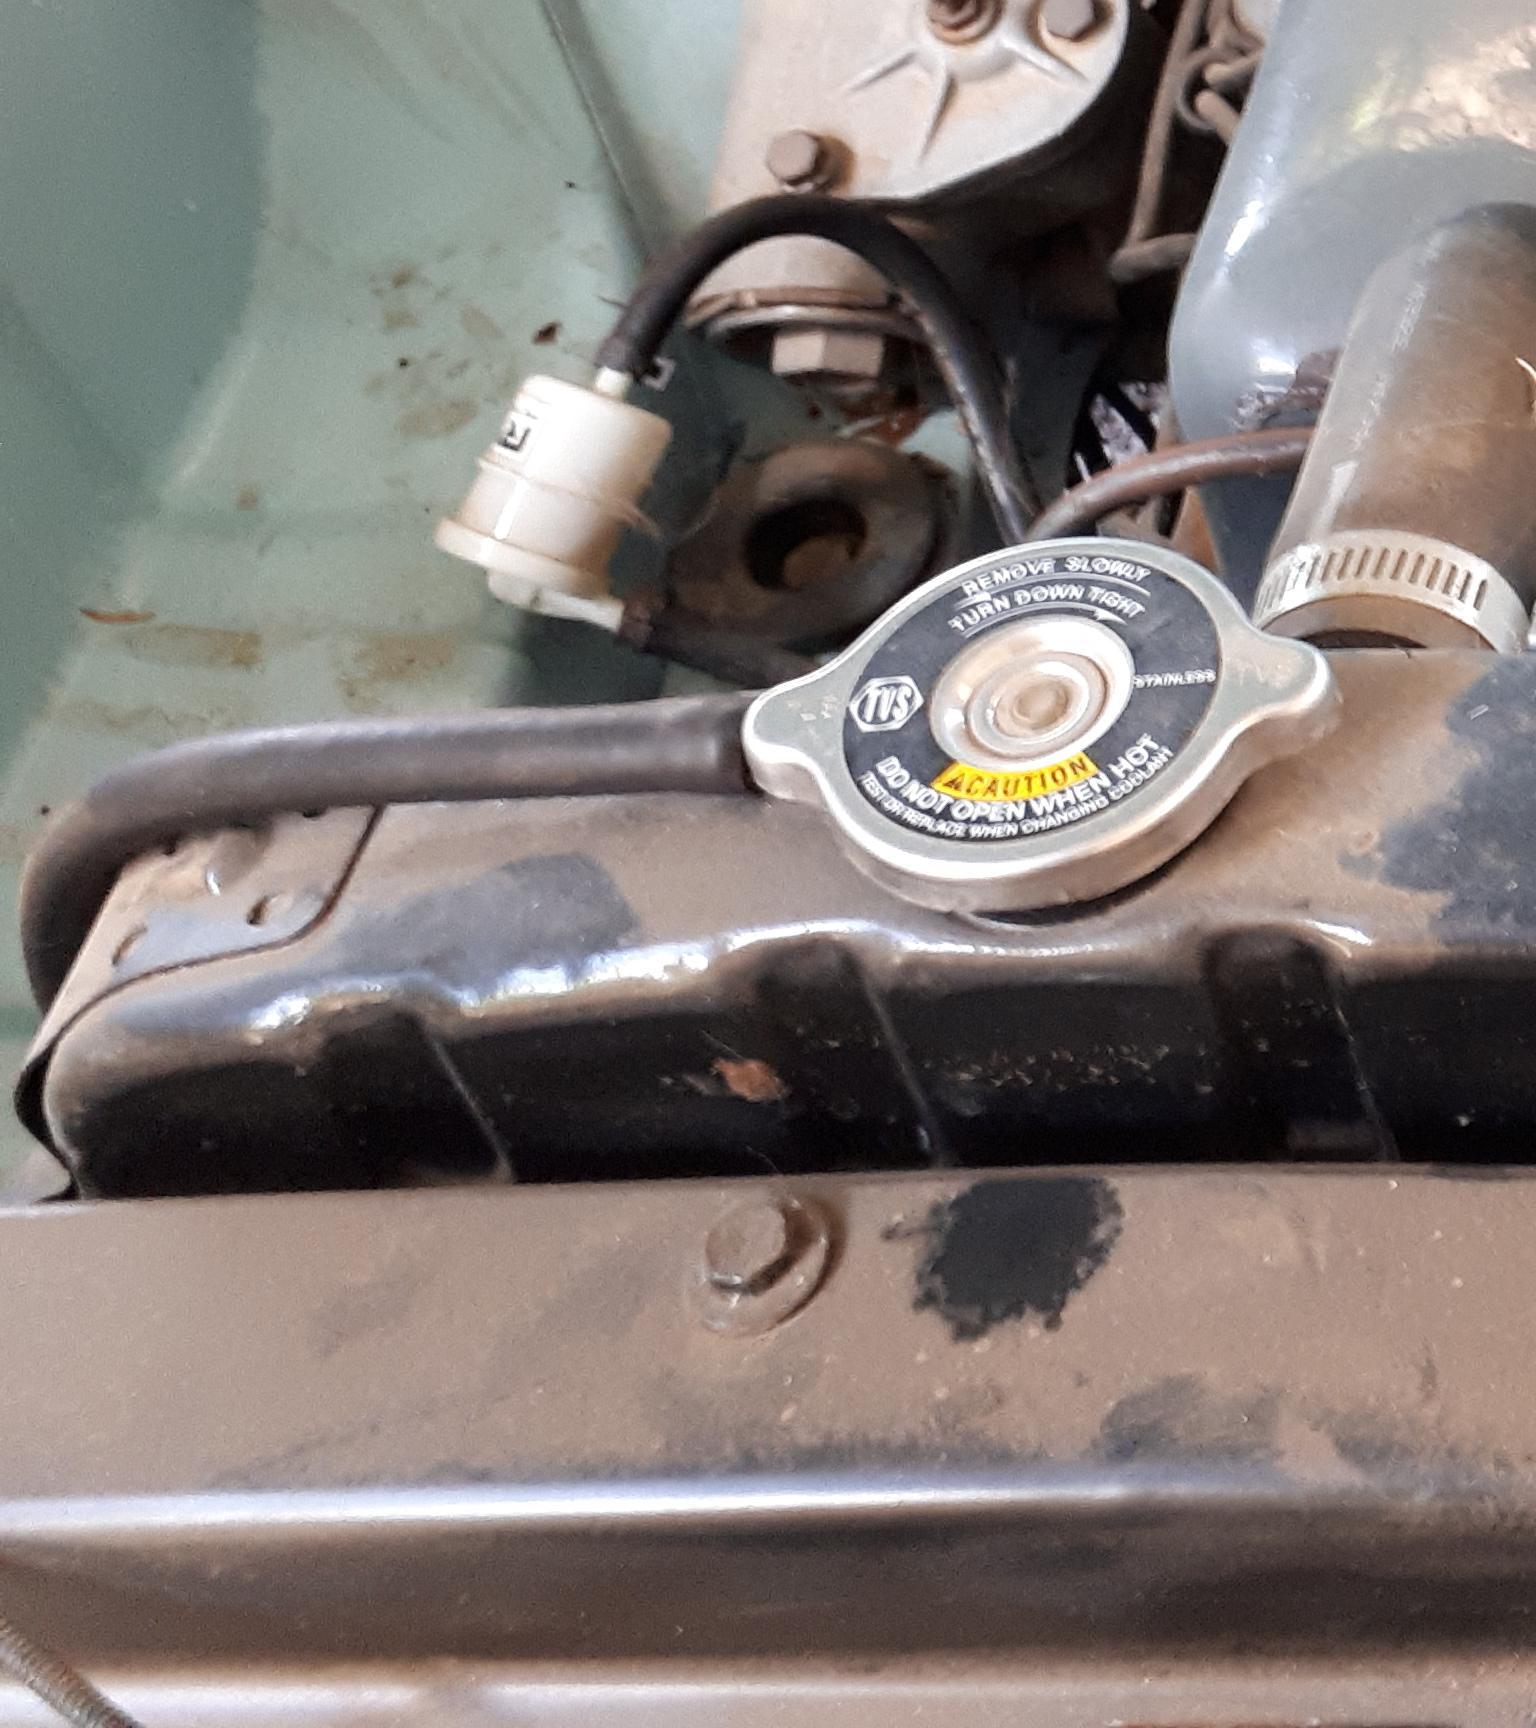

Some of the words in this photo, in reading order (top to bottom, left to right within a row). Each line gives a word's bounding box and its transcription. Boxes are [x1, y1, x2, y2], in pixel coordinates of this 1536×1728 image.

[961, 558, 1056, 597] REMOVE
[1065, 556, 1151, 582] SLOWLY
[948, 595, 1010, 632] TURN
[1015, 584, 1086, 608] DOWN
[1088, 585, 1145, 618] TIGHT
[1133, 670, 1216, 689] STAINLESS
[863, 684, 912, 723] TVS
[875, 755, 907, 790] DO
[904, 783, 954, 817] NOT
[952, 796, 1027, 826] OPEN
[1027, 773, 1111, 821] WHEN
[1108, 733, 1160, 786] HOT
[966, 756, 1089, 796] CAUTION
[858, 770, 888, 804] TEST
[884, 798, 904, 819] OR
[901, 807, 968, 838] REPLACE
[969, 821, 1019, 839] WHEN
[1021, 796, 1108, 836] CHANGING
